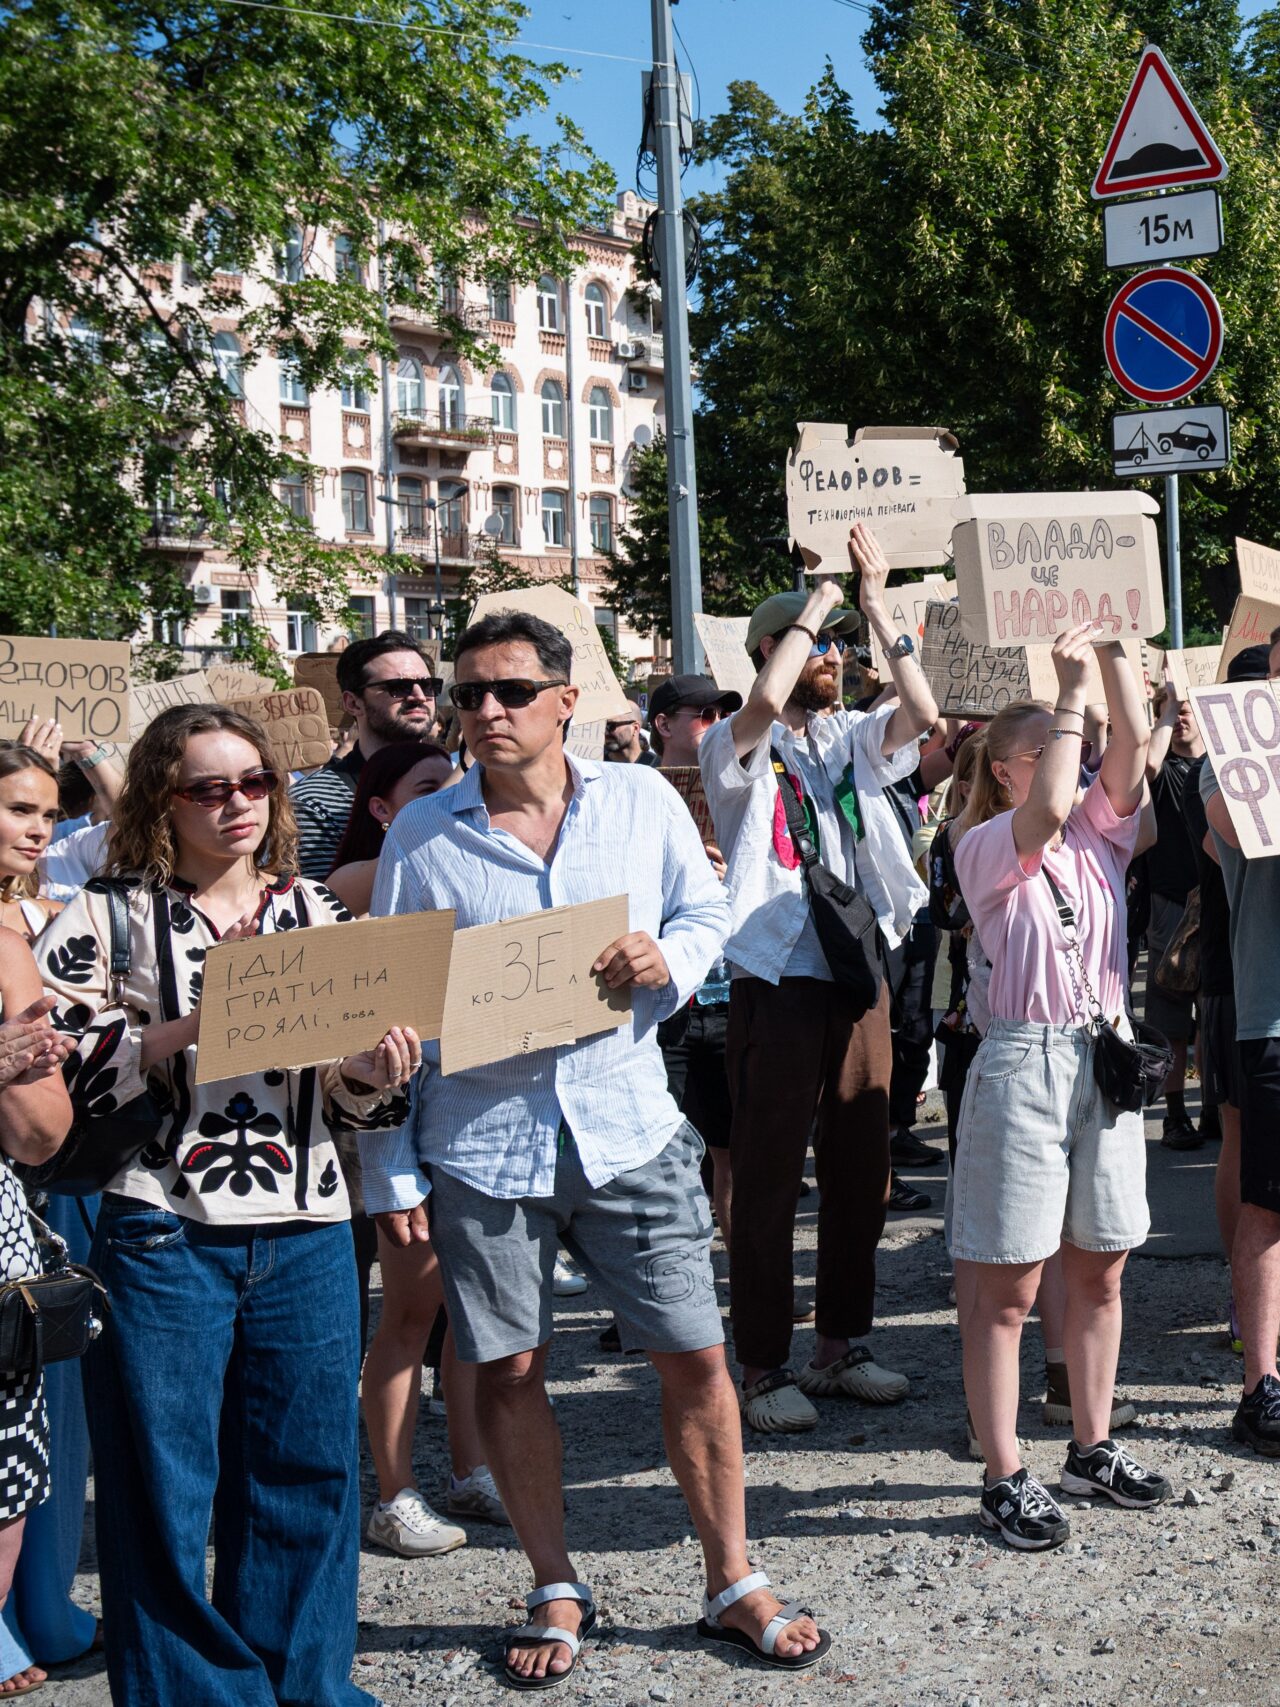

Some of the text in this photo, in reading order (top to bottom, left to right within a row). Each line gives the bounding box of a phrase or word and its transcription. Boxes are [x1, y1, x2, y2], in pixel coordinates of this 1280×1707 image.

[1031, 564, 1059, 587] ЦЕ
[55, 695, 121, 737] МО
[226, 967, 388, 1017] ГРАТИ НА
